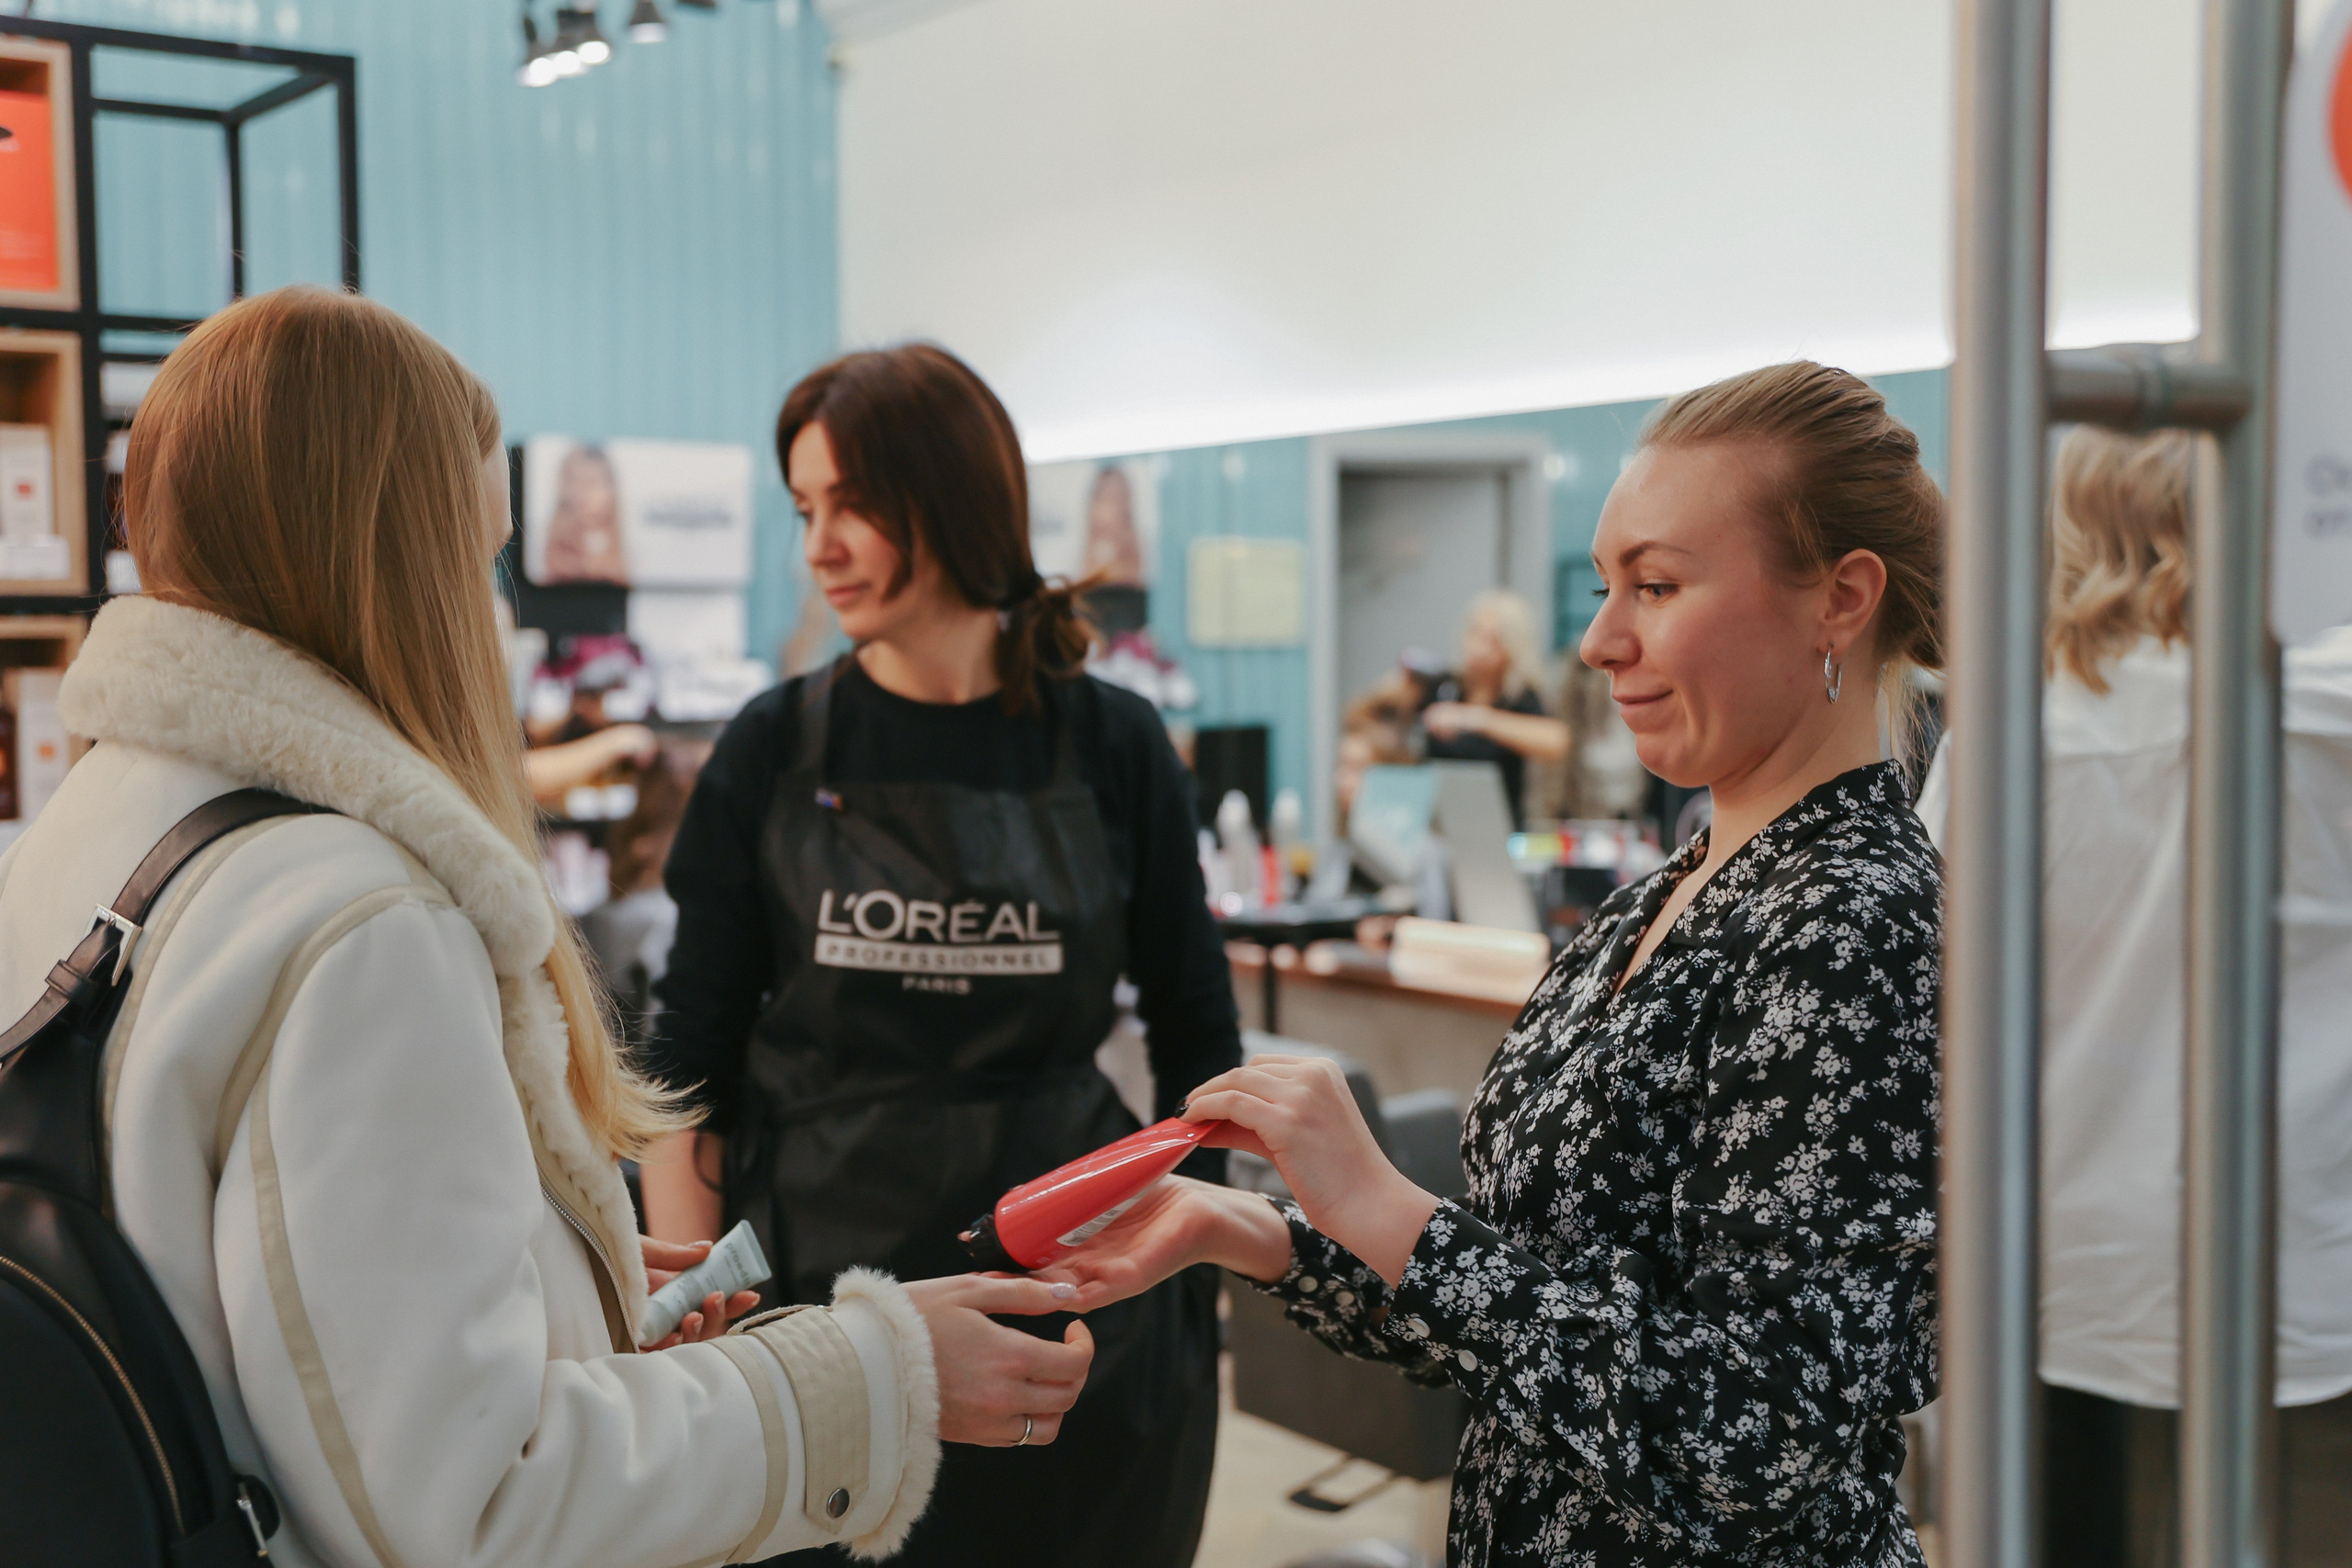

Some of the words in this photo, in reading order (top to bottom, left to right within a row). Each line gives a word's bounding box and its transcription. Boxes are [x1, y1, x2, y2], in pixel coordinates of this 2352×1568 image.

[818, 888, 1060, 942] L'ORÉAL
[828, 942, 1048, 966] PROFESSIONNEL
[902, 976, 971, 995] PARIS
